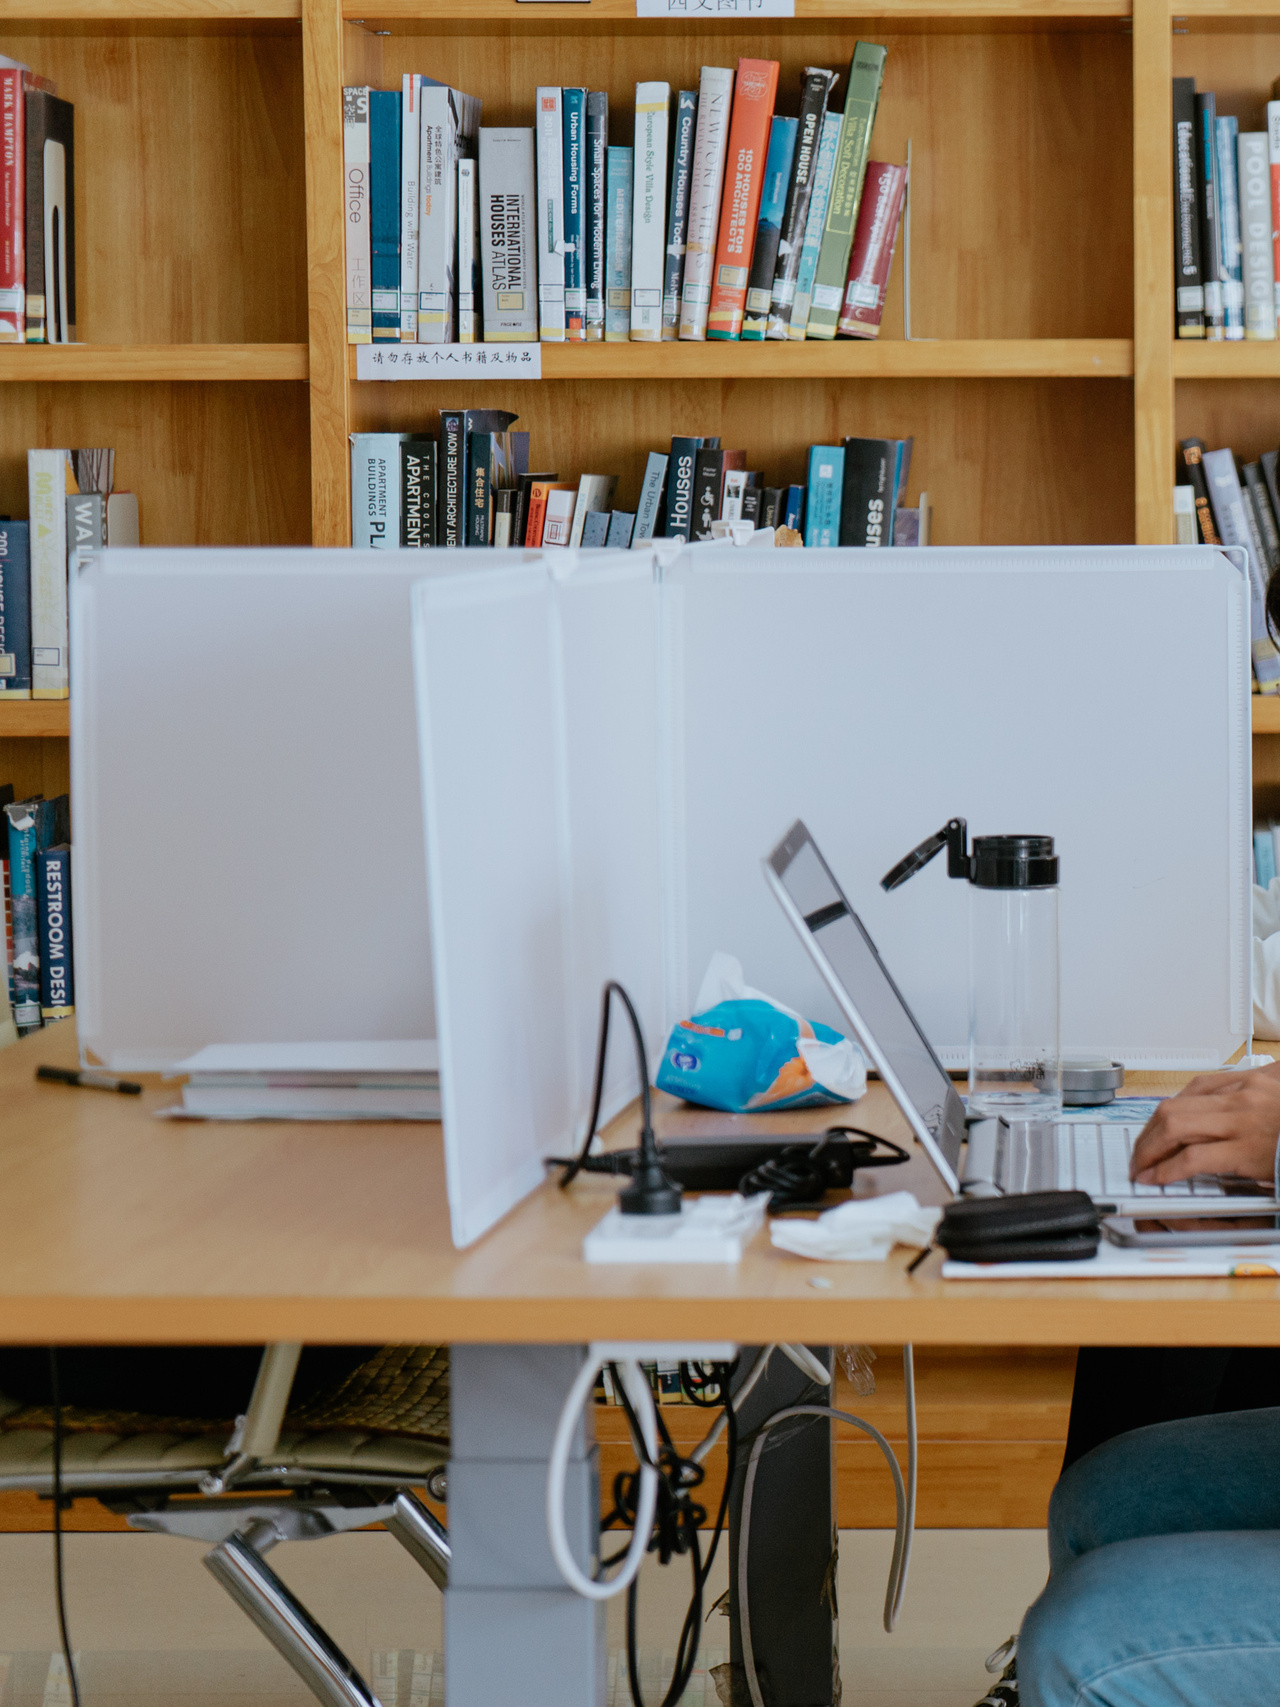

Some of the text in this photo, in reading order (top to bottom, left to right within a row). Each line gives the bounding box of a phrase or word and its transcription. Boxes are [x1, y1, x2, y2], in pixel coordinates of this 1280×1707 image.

[343, 87, 367, 97] SPACE
[4, 77, 14, 166] MARK HAMPTON
[544, 115, 553, 136] 2011
[677, 116, 692, 166] Country
[697, 113, 707, 155] REVIVAL
[796, 113, 817, 184] OPEN HOUSE
[845, 116, 857, 137] Villa
[425, 125, 433, 217] Apartment Buildings today
[569, 111, 579, 214] Urban Housing Forms
[644, 150, 655, 172] Style
[842, 138, 855, 160] Soft
[1177, 121, 1193, 192] Educational
[1245, 140, 1267, 209] POOL
[348, 168, 362, 224] Office
[644, 174, 654, 194] Villa
[675, 169, 686, 217] Houses
[693, 158, 704, 197] STYLES,
[695, 92, 723, 269] NEWPORT VILLAS
[726, 148, 745, 253] 100 ARCHITECTS
[735, 148, 753, 254] 100 HOUSES FOR
[833, 162, 850, 215] Decoration
[878, 172, 891, 192] 150
[406, 180, 416, 270] Building with Water
[591, 139, 602, 289] Small Spaces for Modern Living
[615, 188, 625, 271] MEDITERRANEAN
[643, 195, 654, 224] Design
[491, 194, 506, 290] HOUSES ATLAS
[506, 194, 521, 289] INTERNATIONAL
[351, 258, 366, 306] 工作区
[1182, 266, 1196, 275] 5
[372, 350, 533, 366] 请勿存放个人书籍及物品
[422, 455, 430, 481] THE
[446, 432, 458, 463] NOW
[367, 458, 376, 517] BUILDINGS
[378, 458, 387, 518] APARTMENT
[406, 455, 421, 548] APARTMENT
[447, 464, 458, 530] ARCHITECTURE
[475, 467, 486, 508] 集合住宅
[643, 490, 656, 519] Urban
[649, 470, 660, 488] The
[670, 455, 692, 527] Houses
[46, 860, 64, 959] RESTROOM
